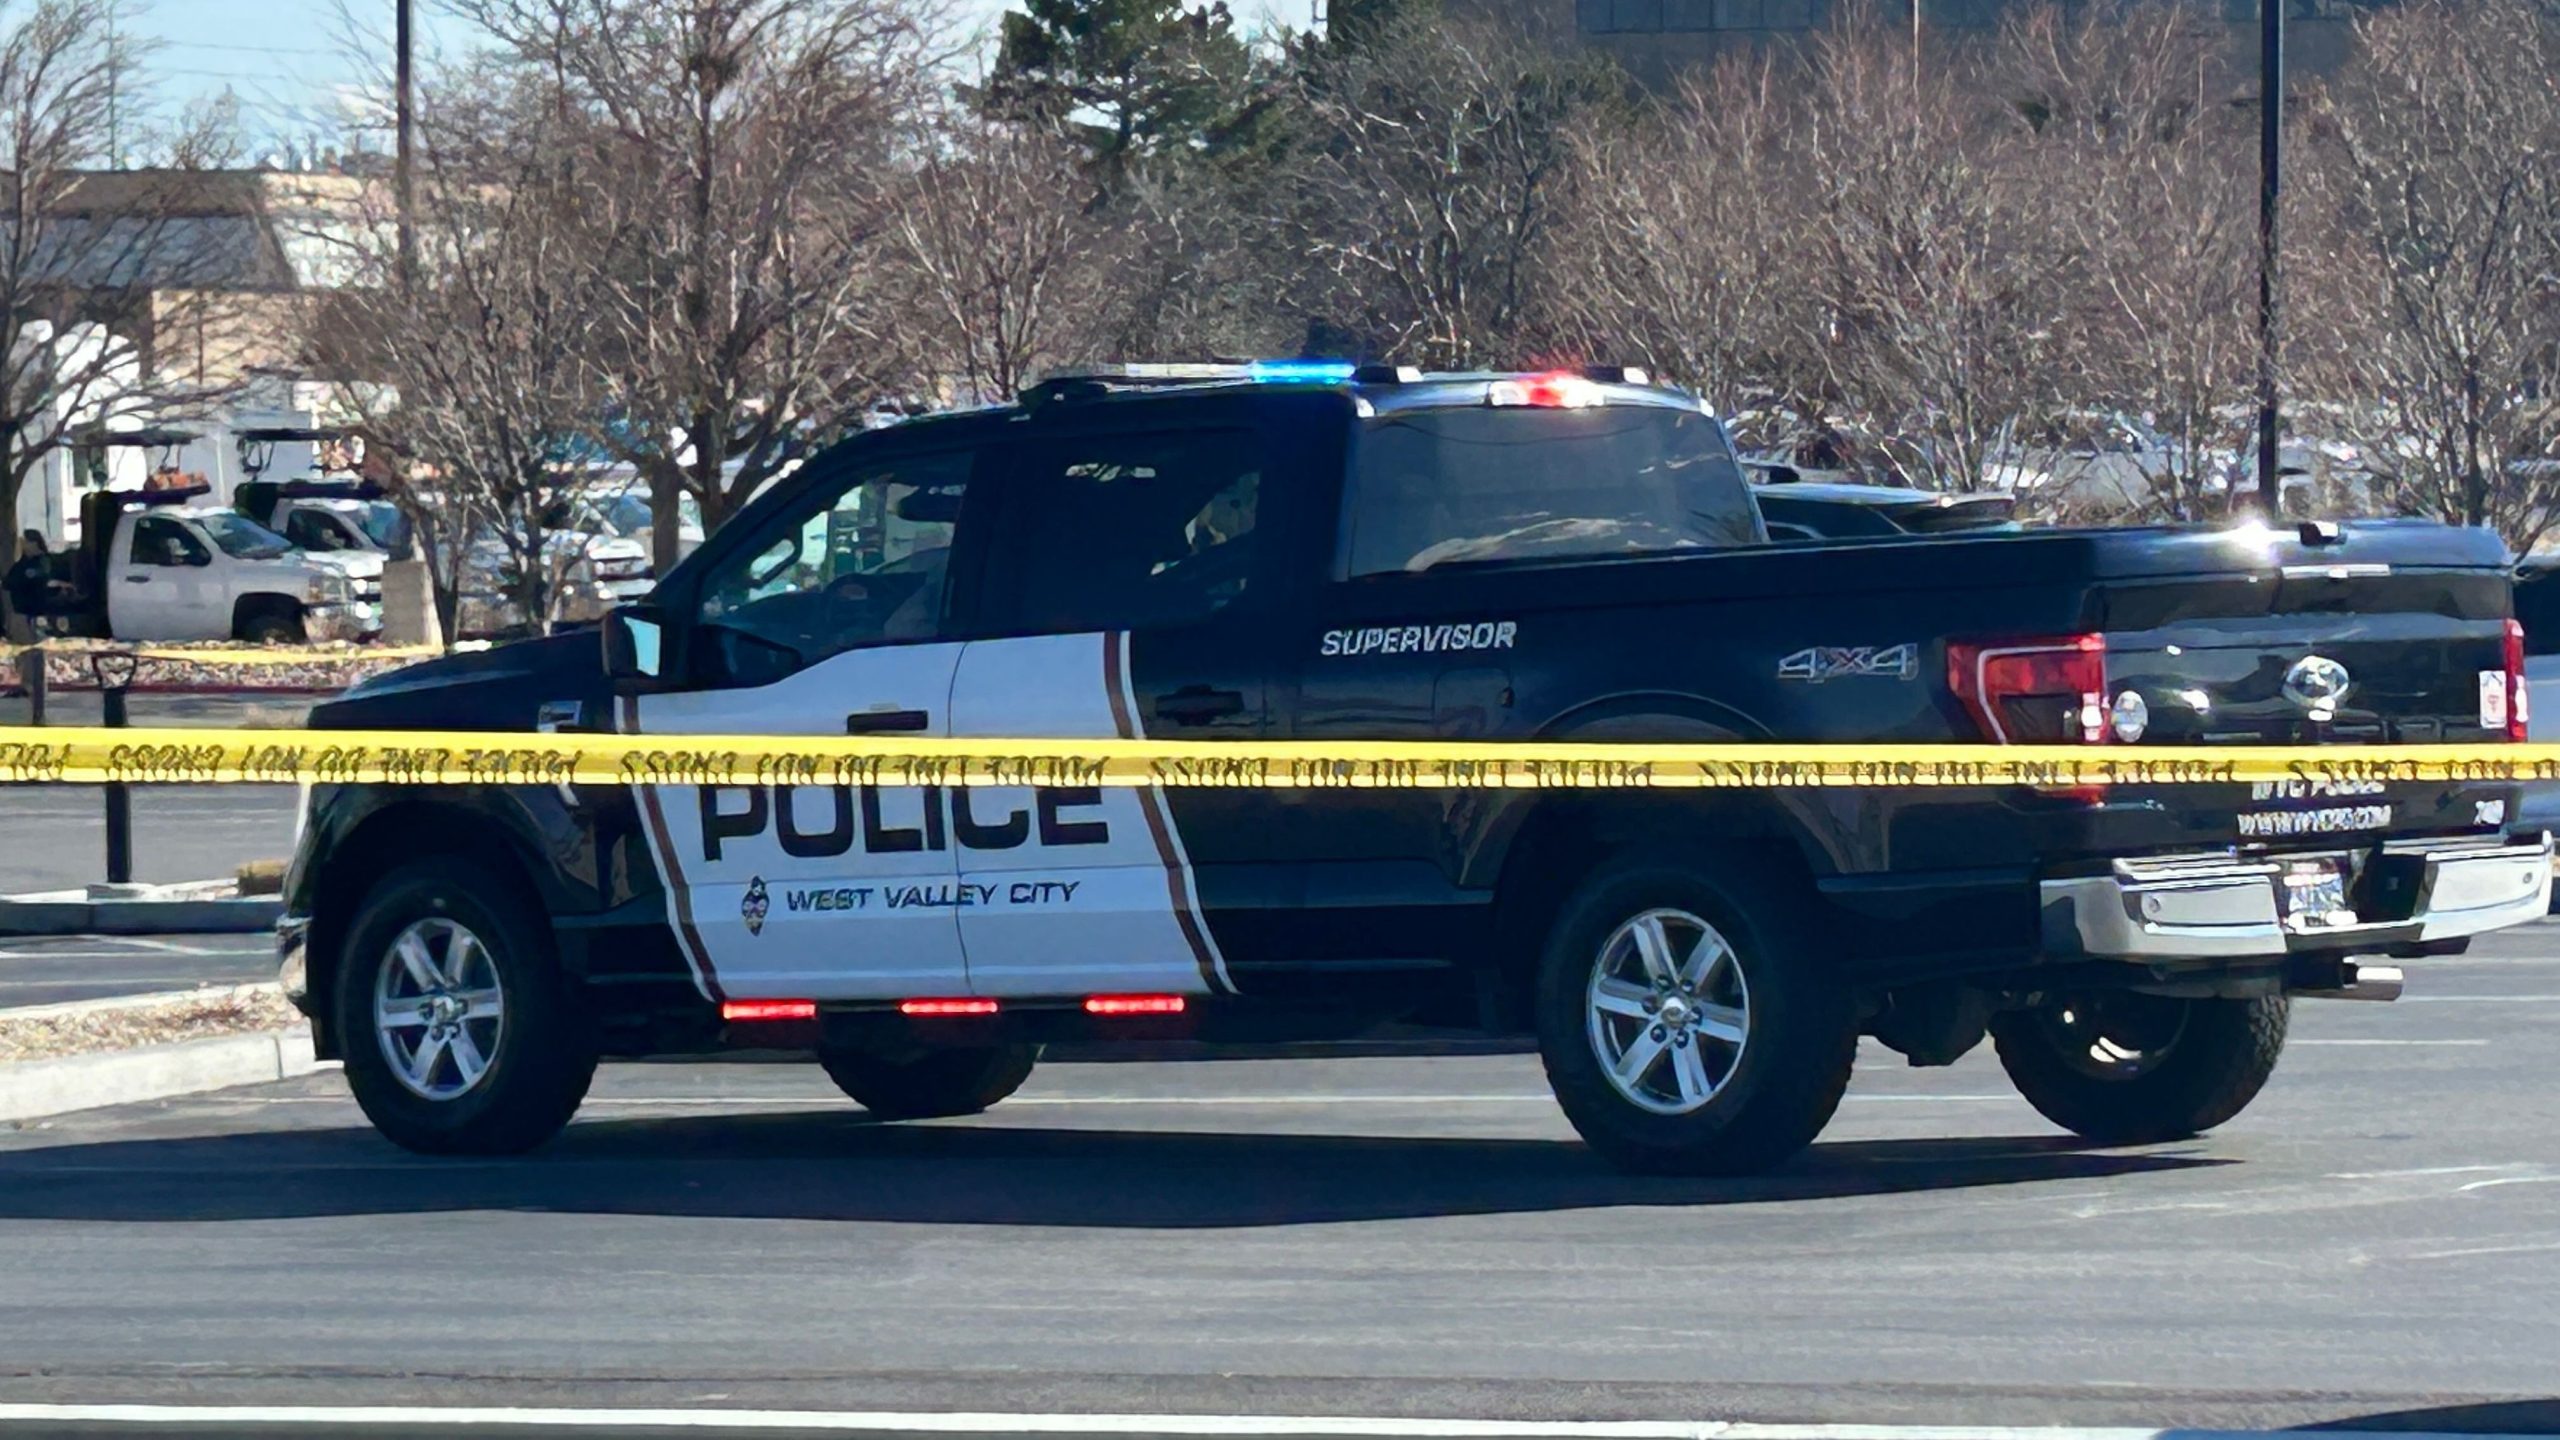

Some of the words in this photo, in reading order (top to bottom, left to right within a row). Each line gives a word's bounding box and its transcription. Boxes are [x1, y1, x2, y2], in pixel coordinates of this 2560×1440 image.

[1321, 621, 1517, 656] SUPERVISOR
[700, 785, 1108, 861] POLICE
[787, 887, 874, 911] WEST
[884, 883, 998, 908] VALLEY
[1009, 881, 1081, 904] CITY
